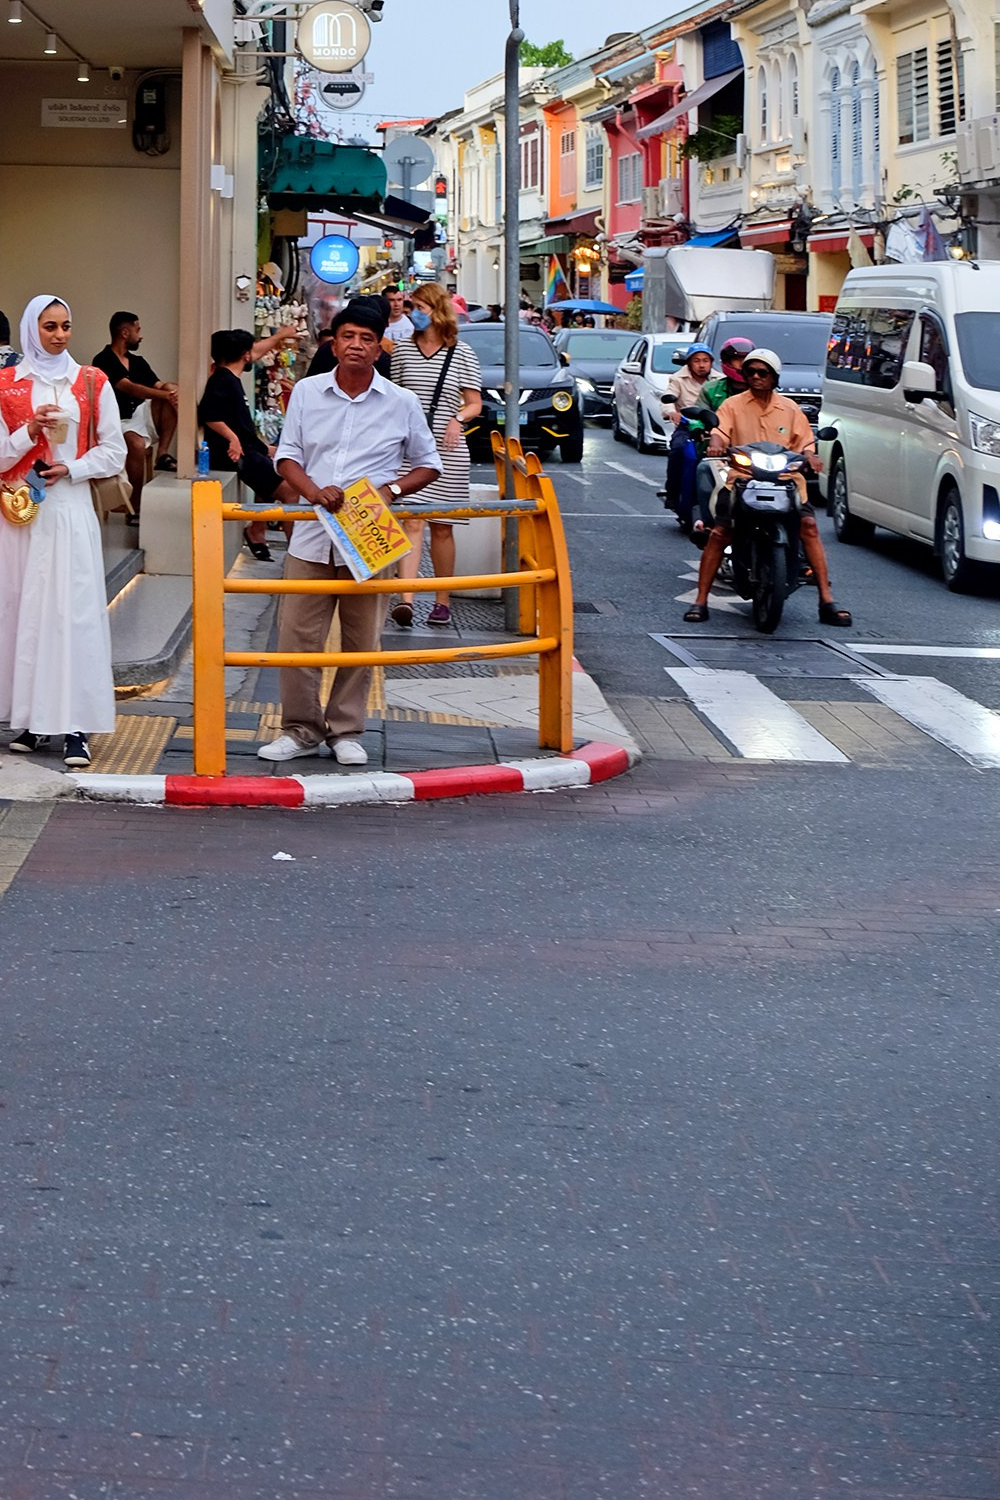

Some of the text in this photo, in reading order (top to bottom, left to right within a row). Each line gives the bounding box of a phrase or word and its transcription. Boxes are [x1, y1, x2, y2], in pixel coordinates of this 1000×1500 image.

[312, 47, 357, 56] MONDO
[342, 501, 385, 561] SERVICE
[349, 496, 369, 519] OLD
[367, 519, 392, 554] TOWN
[358, 482, 406, 549] TAXI
